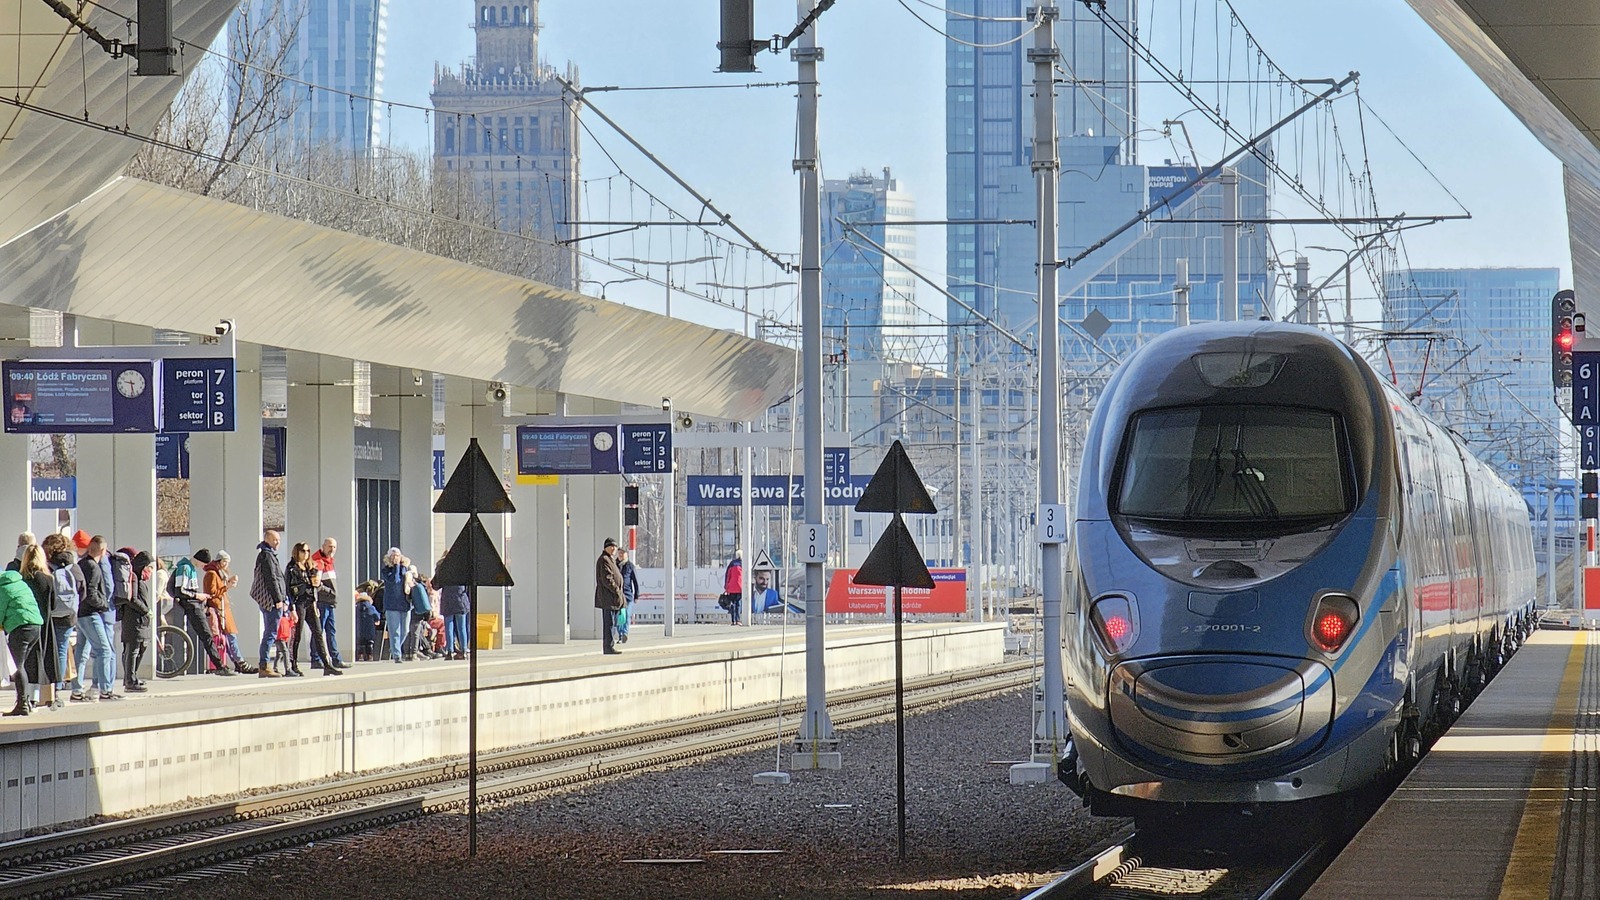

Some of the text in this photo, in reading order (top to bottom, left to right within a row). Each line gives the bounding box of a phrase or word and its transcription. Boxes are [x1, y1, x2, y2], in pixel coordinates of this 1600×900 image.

[11, 371, 108, 383] 09:40 Łódź Fabryczna
[176, 369, 226, 385] peron 7
[1580, 363, 1591, 379] 6
[191, 391, 225, 405] tor 3
[1582, 386, 1589, 399] 1
[179, 411, 224, 426] sektor B
[1580, 405, 1592, 419] A
[632, 431, 652, 439] peron
[658, 431, 666, 442] 7
[1585, 426, 1594, 438] 6
[658, 446, 666, 456] 3
[1587, 442, 1593, 451] 1
[657, 459, 666, 470] B
[838, 453, 846, 463] 7
[1586, 455, 1595, 465] A
[838, 465, 845, 474] 3
[838, 476, 846, 484] A
[32, 486, 67, 501] hodnia
[699, 484, 785, 499] Warsawa
[1047, 508, 1054, 522] 3
[809, 528, 816, 542] 3
[1046, 524, 1054, 538] 0
[808, 544, 816, 558] 0
[1180, 624, 1261, 633] 2 370001-2
